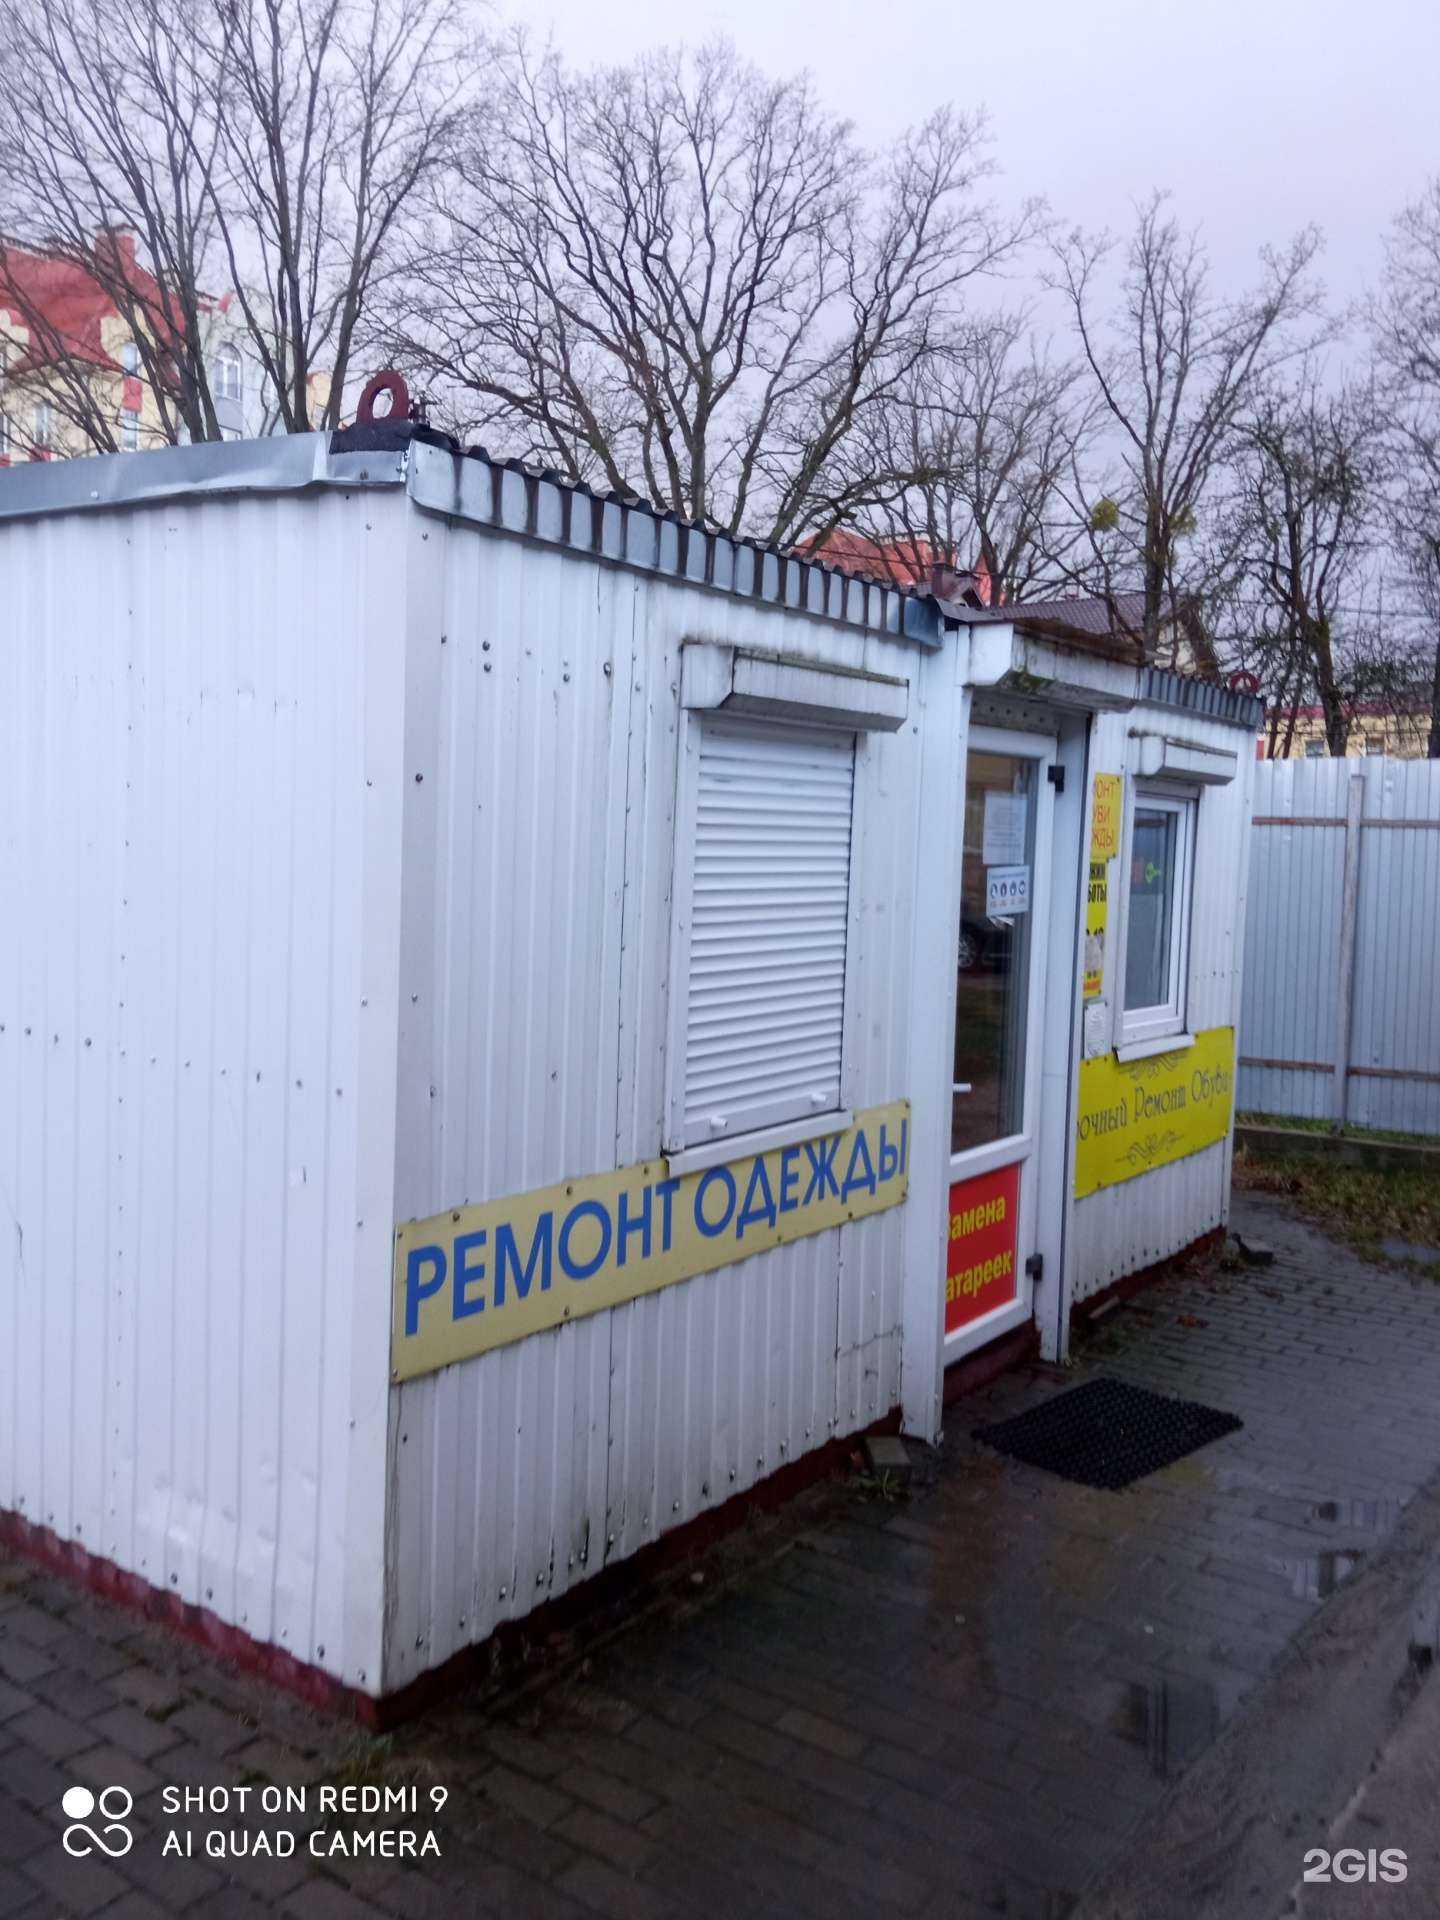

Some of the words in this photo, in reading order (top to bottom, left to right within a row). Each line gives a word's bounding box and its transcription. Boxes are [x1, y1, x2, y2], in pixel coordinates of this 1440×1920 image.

[1093, 778, 1114, 800] ОНТ
[1077, 1098, 1128, 1141] очный
[405, 1176, 681, 1336] РЕМОНТ
[693, 1118, 907, 1239] ОДЕЖДЫ
[948, 1196, 1006, 1241] амена
[945, 1251, 1012, 1303] атареек
